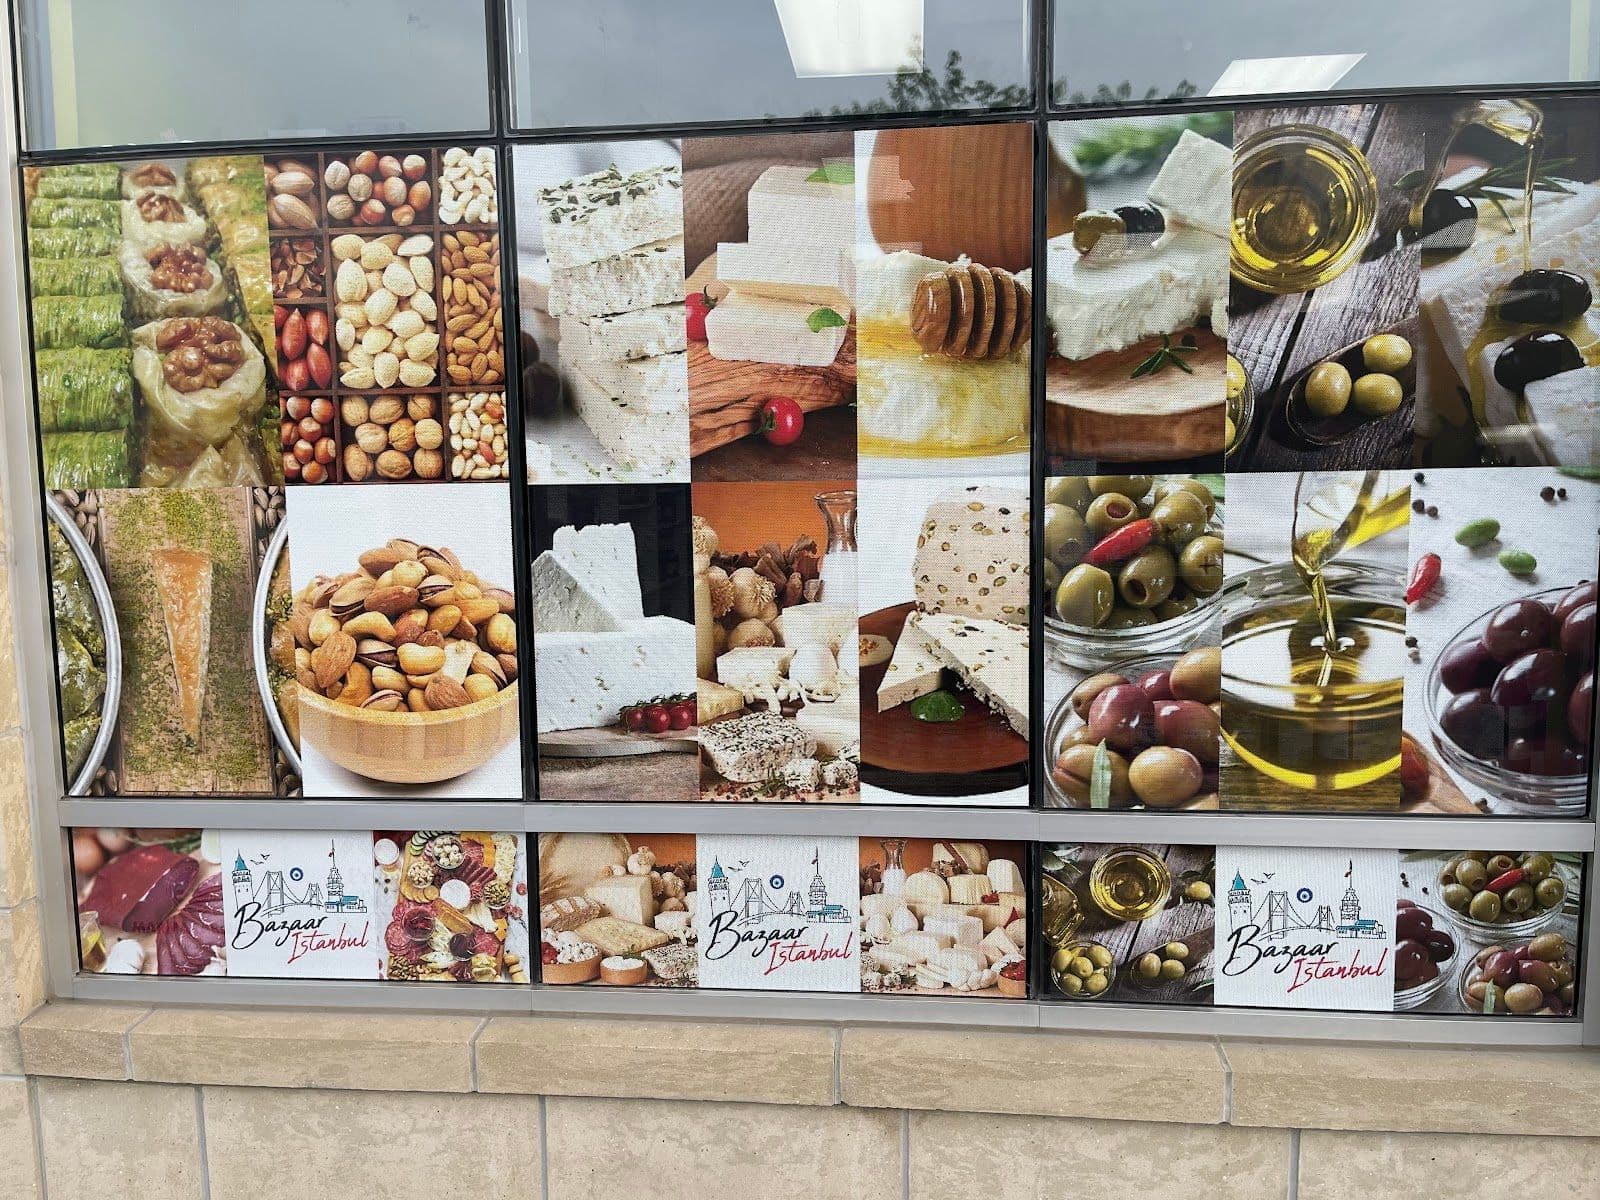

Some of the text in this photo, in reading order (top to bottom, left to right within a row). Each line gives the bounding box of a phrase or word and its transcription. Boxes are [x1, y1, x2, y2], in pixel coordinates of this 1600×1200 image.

[231, 902, 328, 950] Bazaar
[287, 921, 369, 964] Istanbul
[705, 911, 809, 960] Bazaar
[764, 931, 853, 976] Istanbul
[1222, 924, 1339, 976] Bazaar
[1287, 947, 1388, 993] Istanbul
